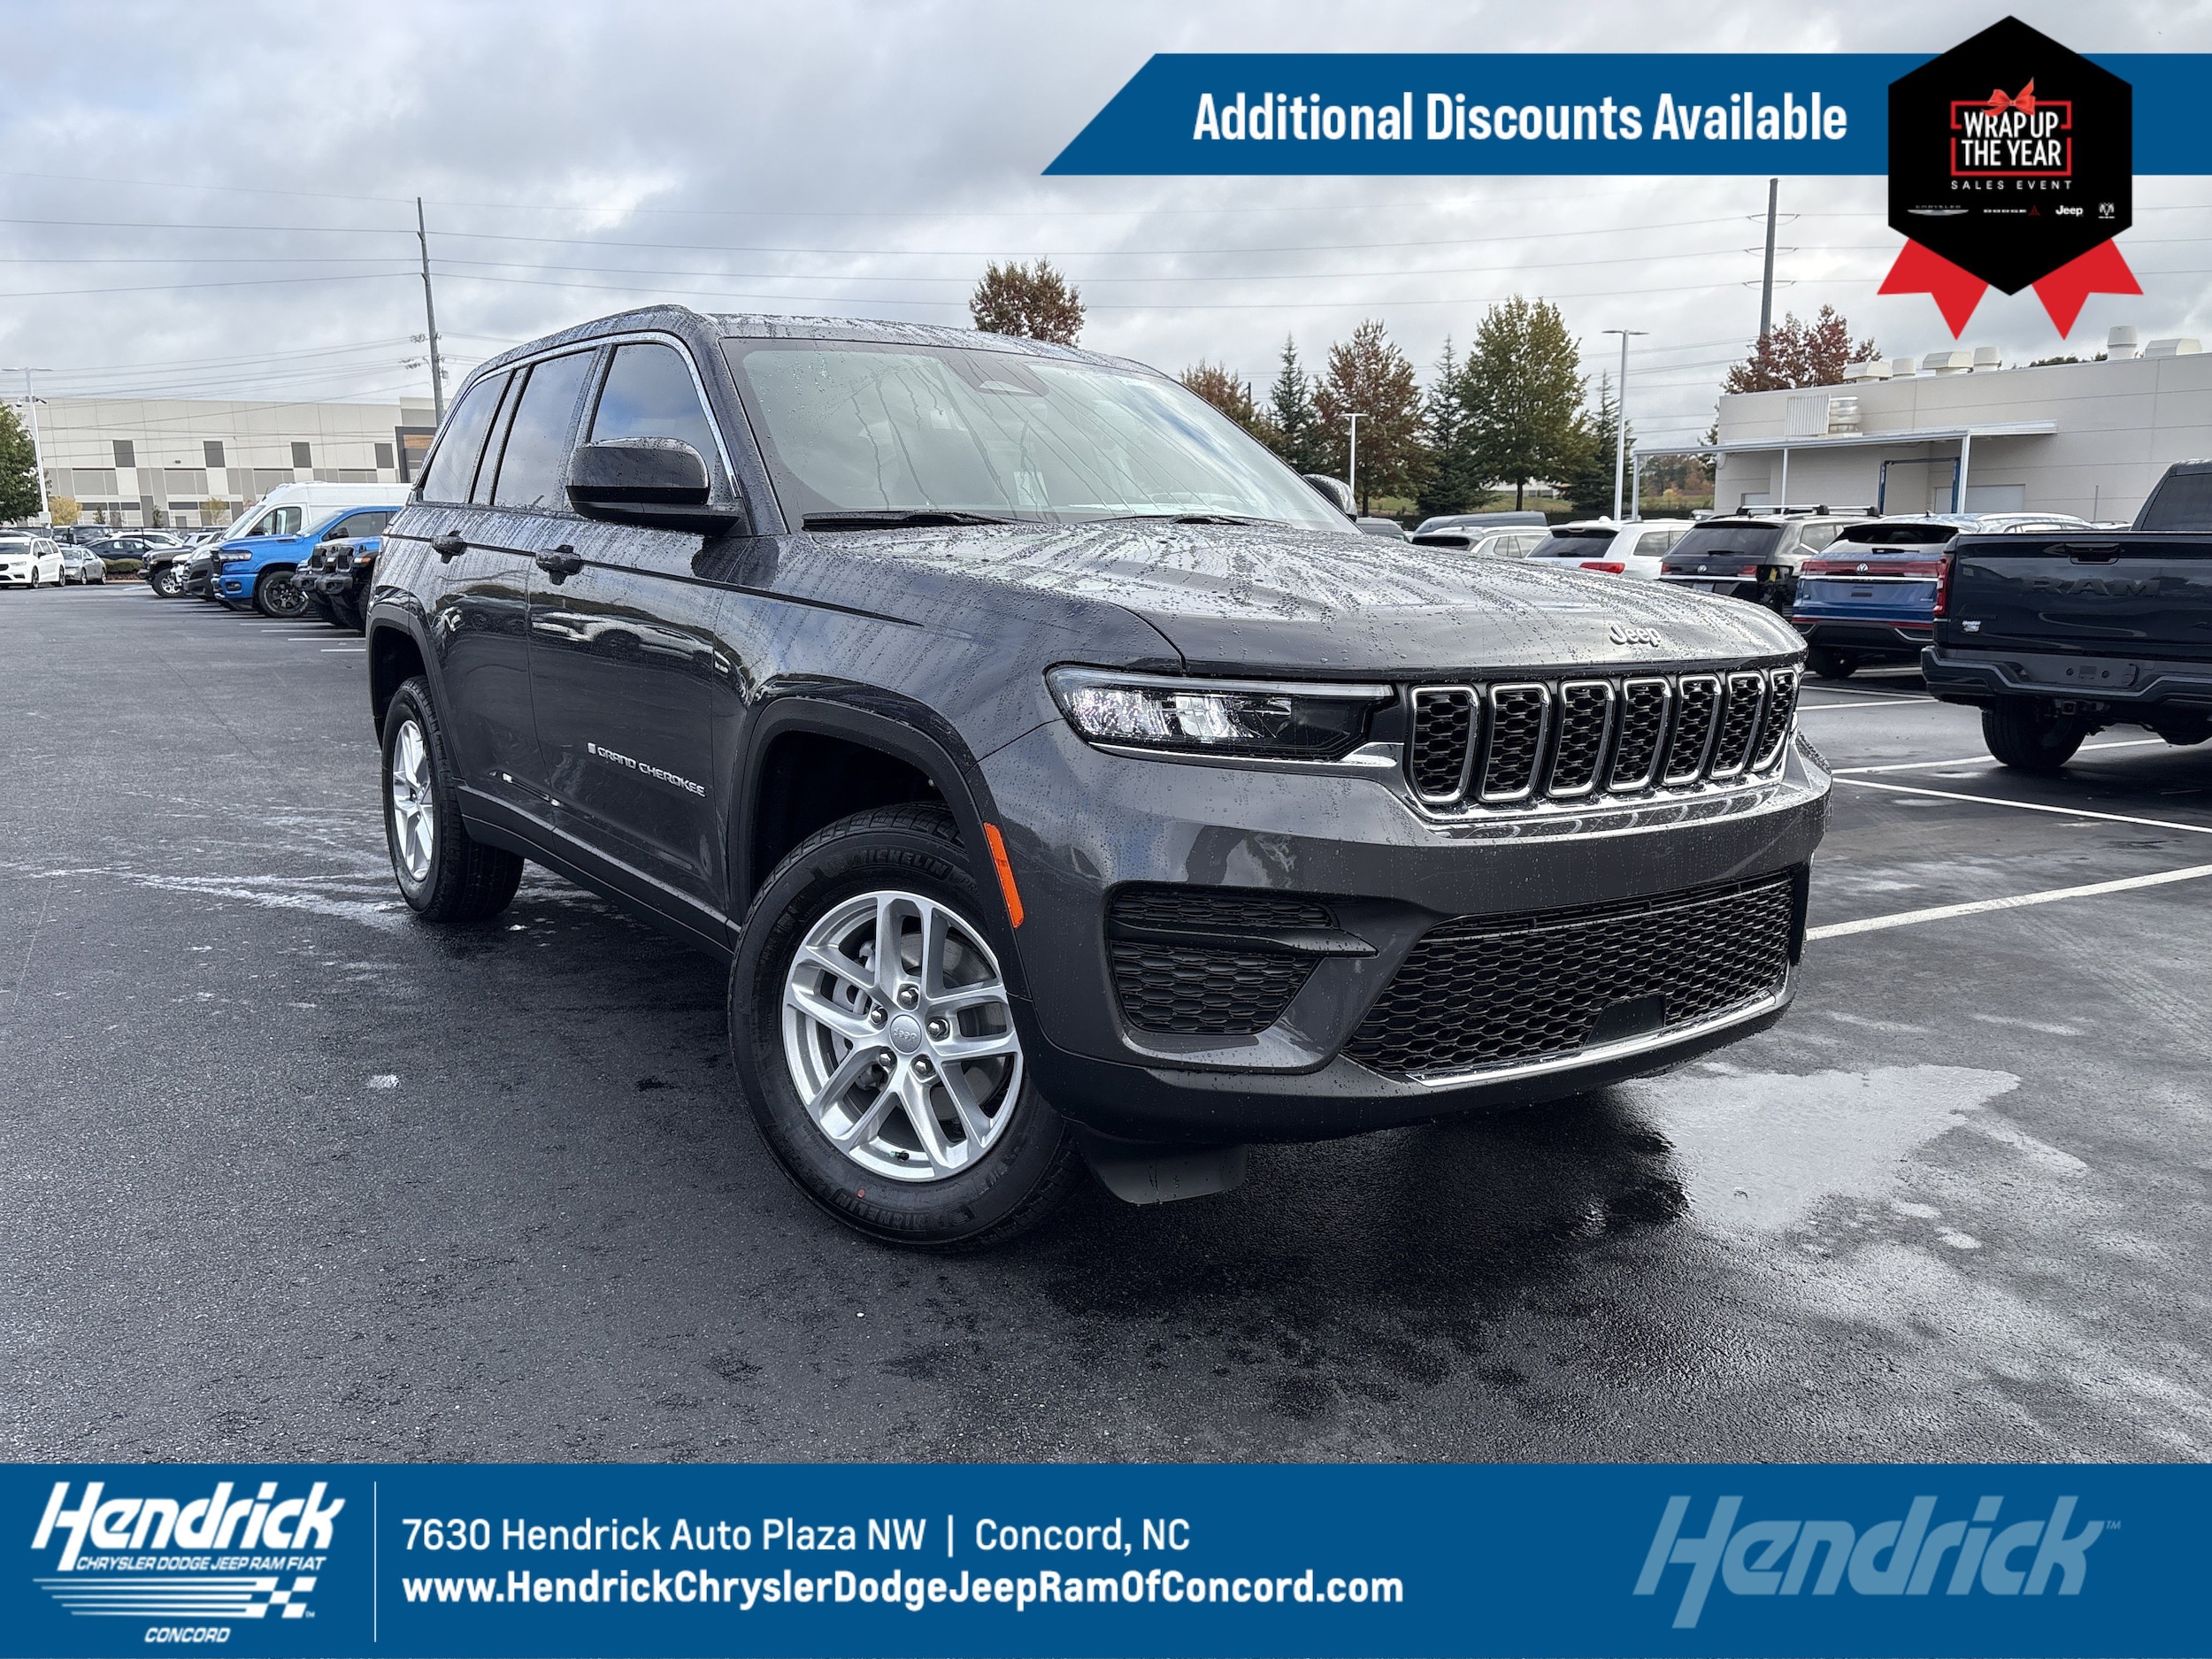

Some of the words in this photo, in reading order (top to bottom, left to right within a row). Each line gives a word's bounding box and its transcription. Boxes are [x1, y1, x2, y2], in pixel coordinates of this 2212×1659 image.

[2022, 577, 2161, 597] RAM
[1609, 624, 1662, 648] Jeep
[597, 746, 638, 770] GRAND
[638, 762, 707, 797] CHEROKEE
